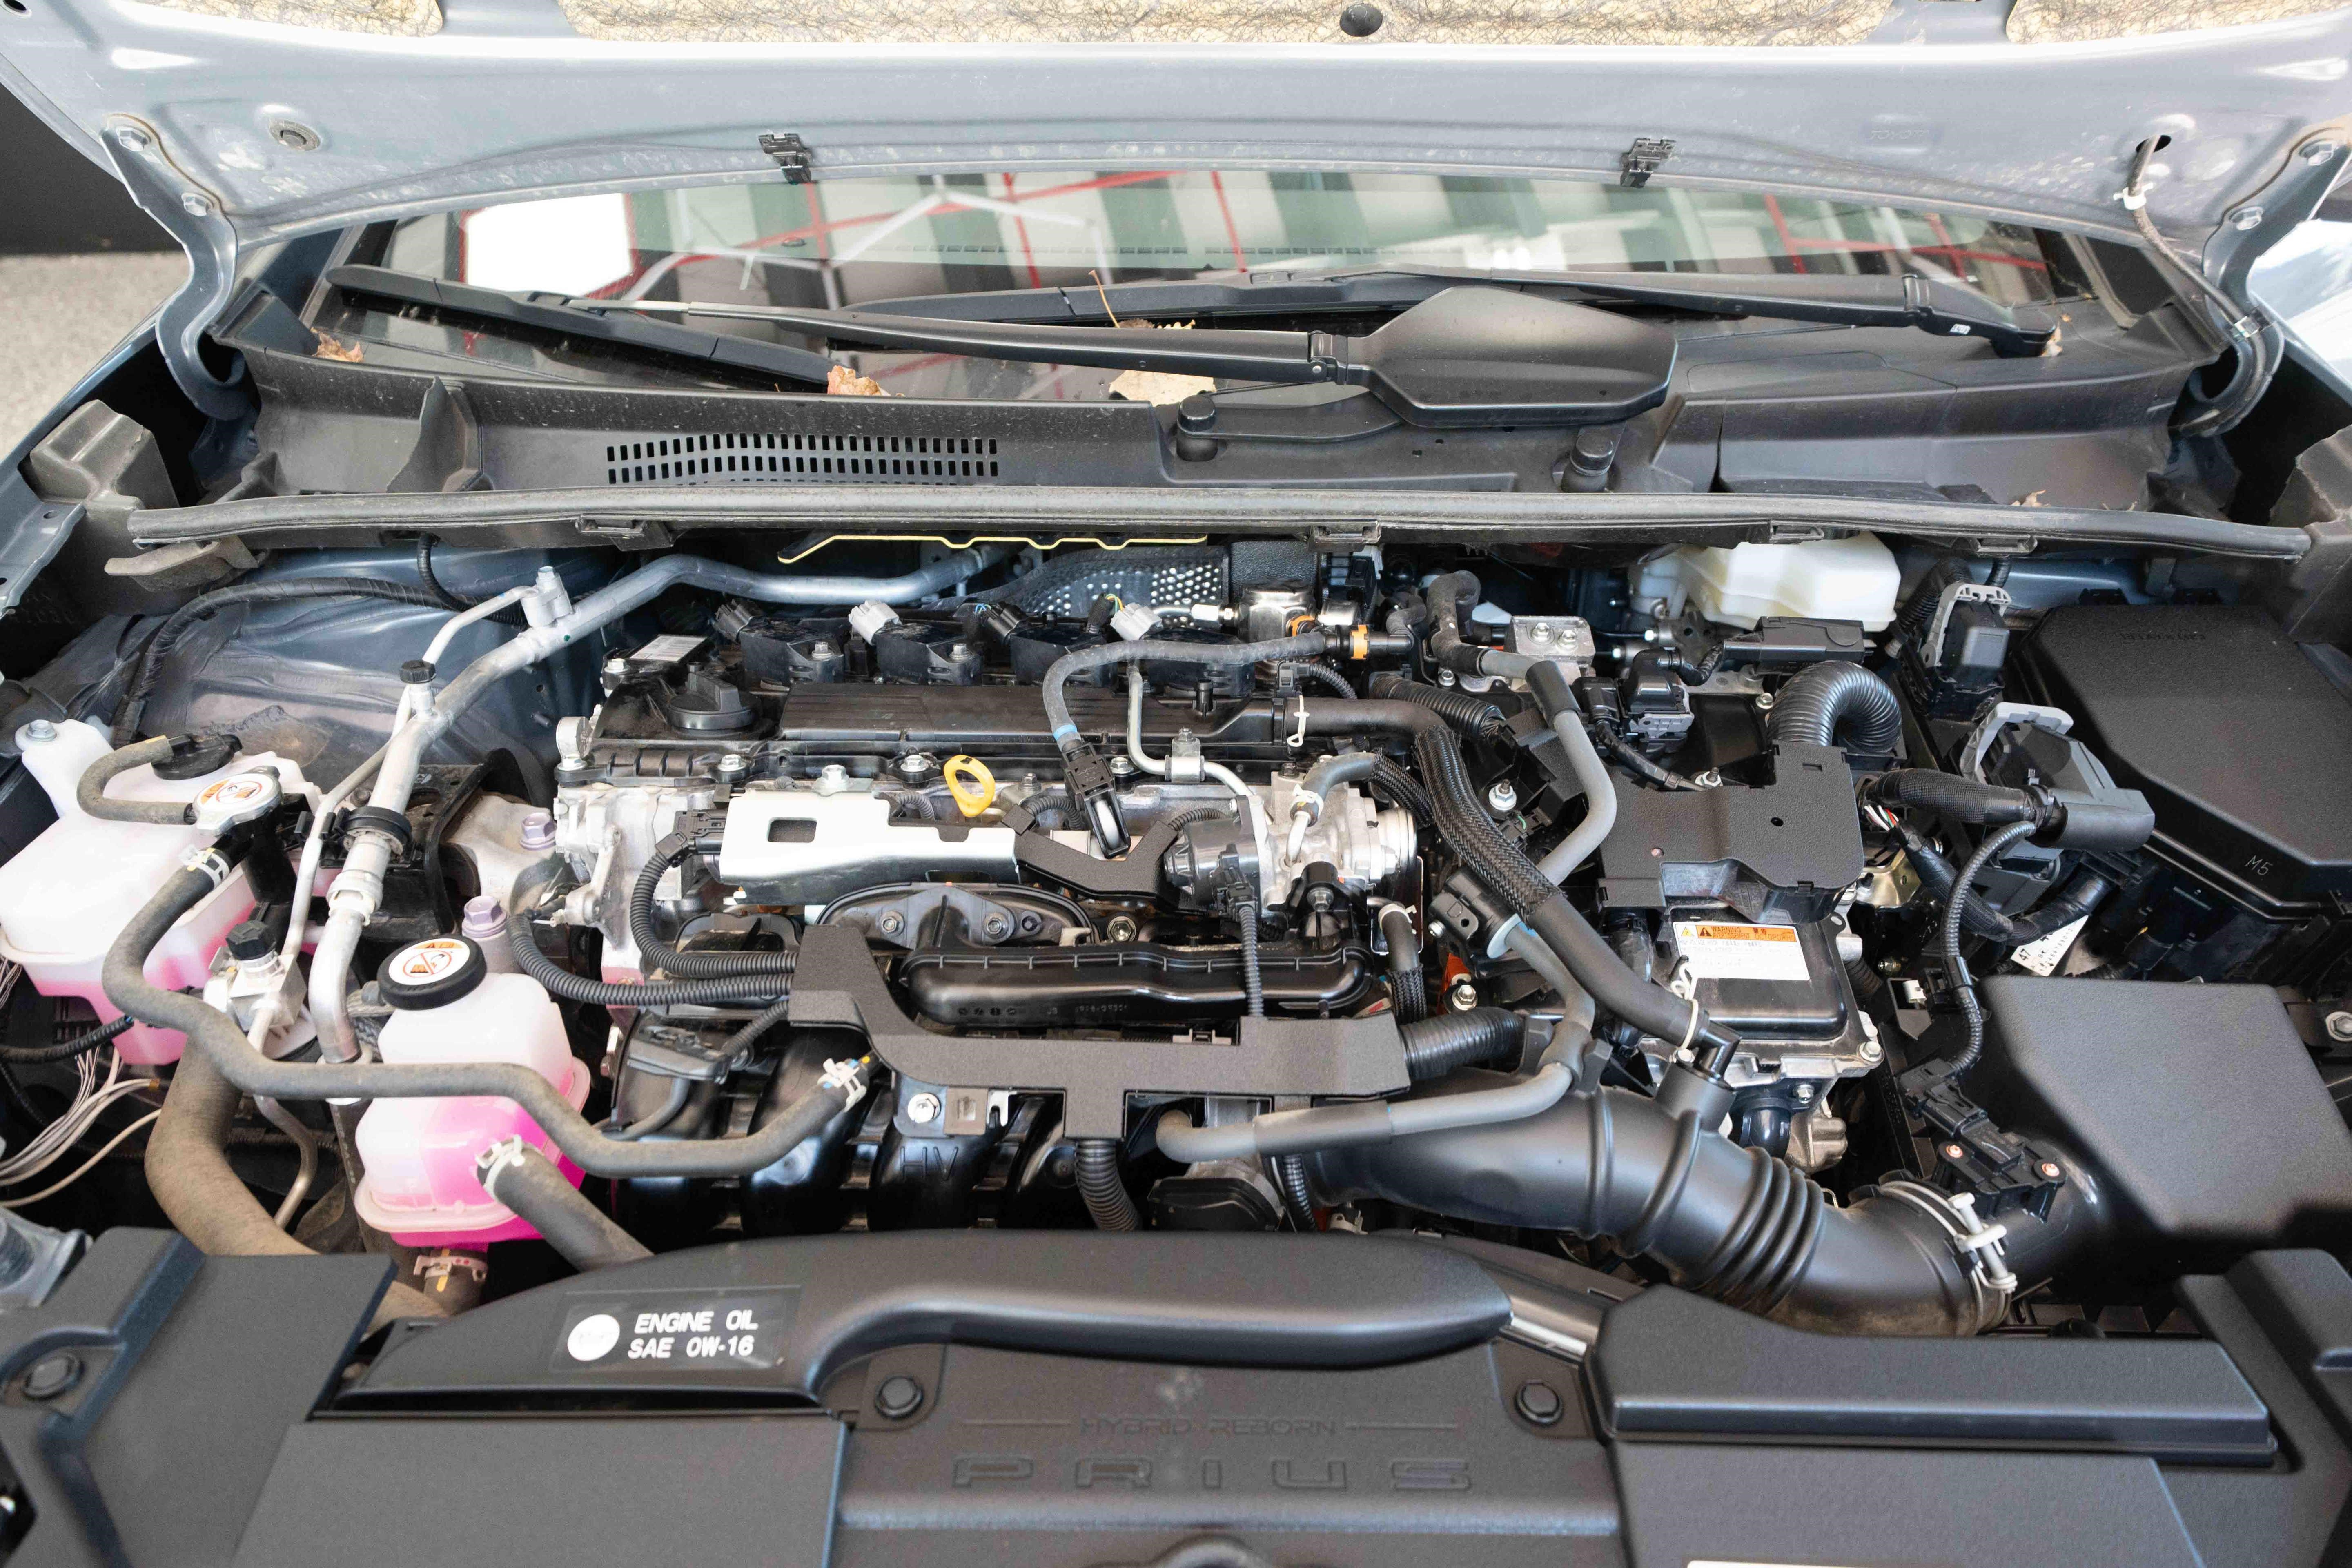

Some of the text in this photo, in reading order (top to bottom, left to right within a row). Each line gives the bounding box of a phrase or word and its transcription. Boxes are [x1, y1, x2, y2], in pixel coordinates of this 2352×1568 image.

[2245, 855, 2274, 875] M5
[2018, 948, 2031, 961] 47
[900, 1145, 959, 1181] HV
[634, 1309, 758, 1334] ENGINE OIL
[627, 1335, 755, 1359] SAE 0W-16
[1080, 1418, 1337, 1437] HYBRID REBORN
[951, 1454, 1470, 1490] PRIUS
